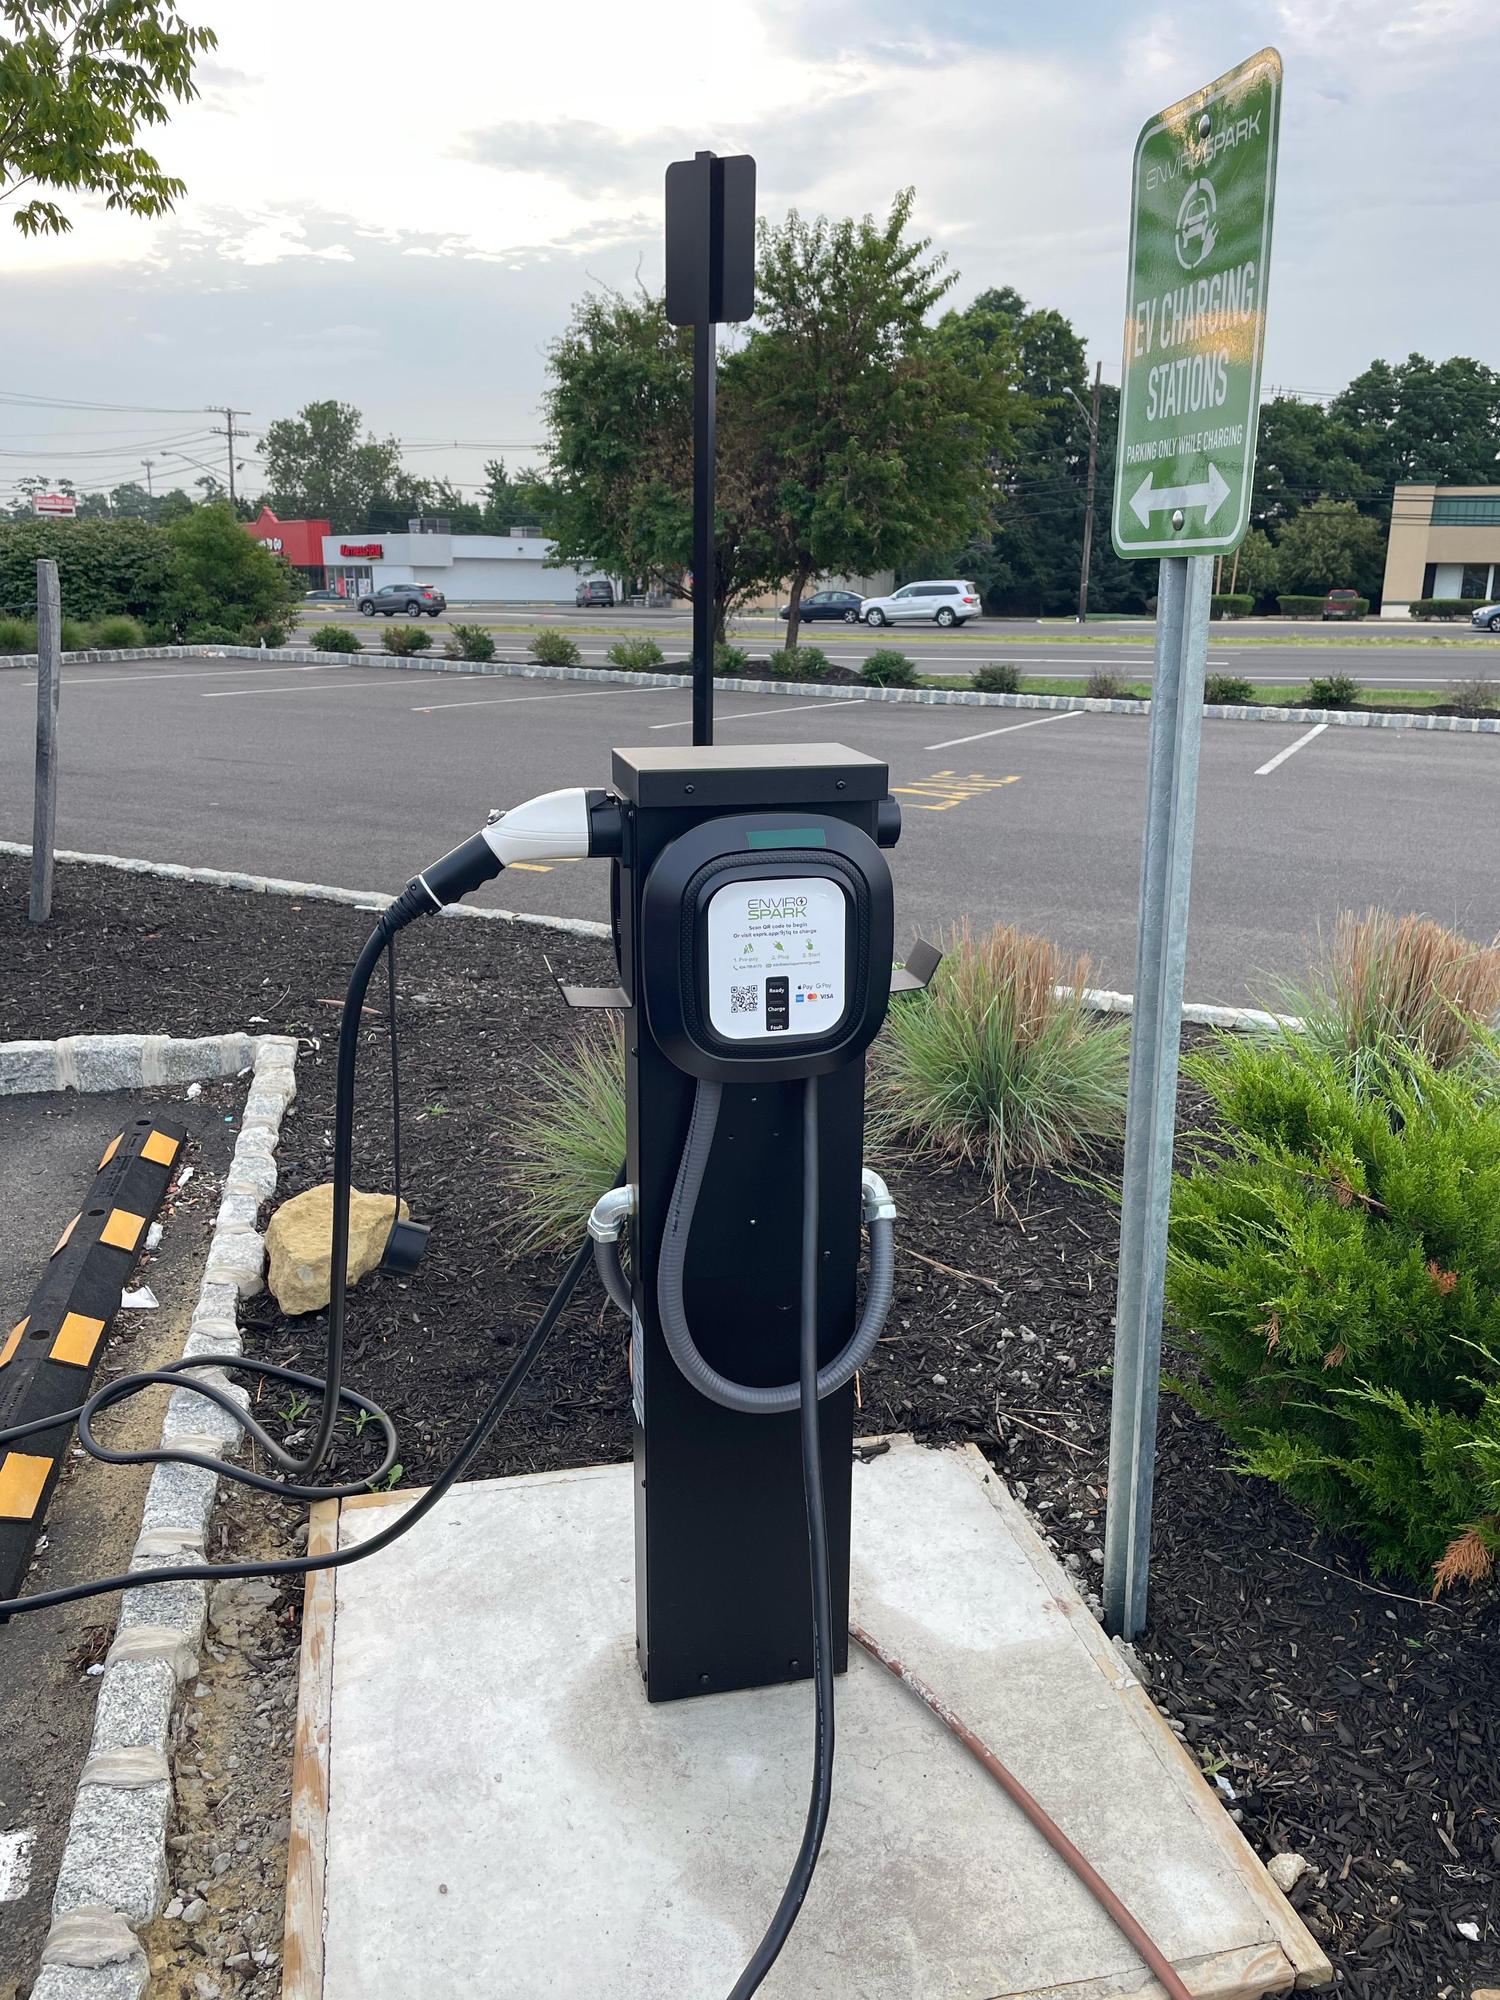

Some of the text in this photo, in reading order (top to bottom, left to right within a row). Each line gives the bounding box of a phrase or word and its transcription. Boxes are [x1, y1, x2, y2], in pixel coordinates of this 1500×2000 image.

[1134, 261, 1255, 358] EV CHARGING
[1146, 346, 1230, 422] STATIONS
[1126, 424, 1243, 463] PARKING ONLY WHILE CHARGING
[747, 896, 808, 910] ENVIRO
[747, 906, 808, 921] SPARK
